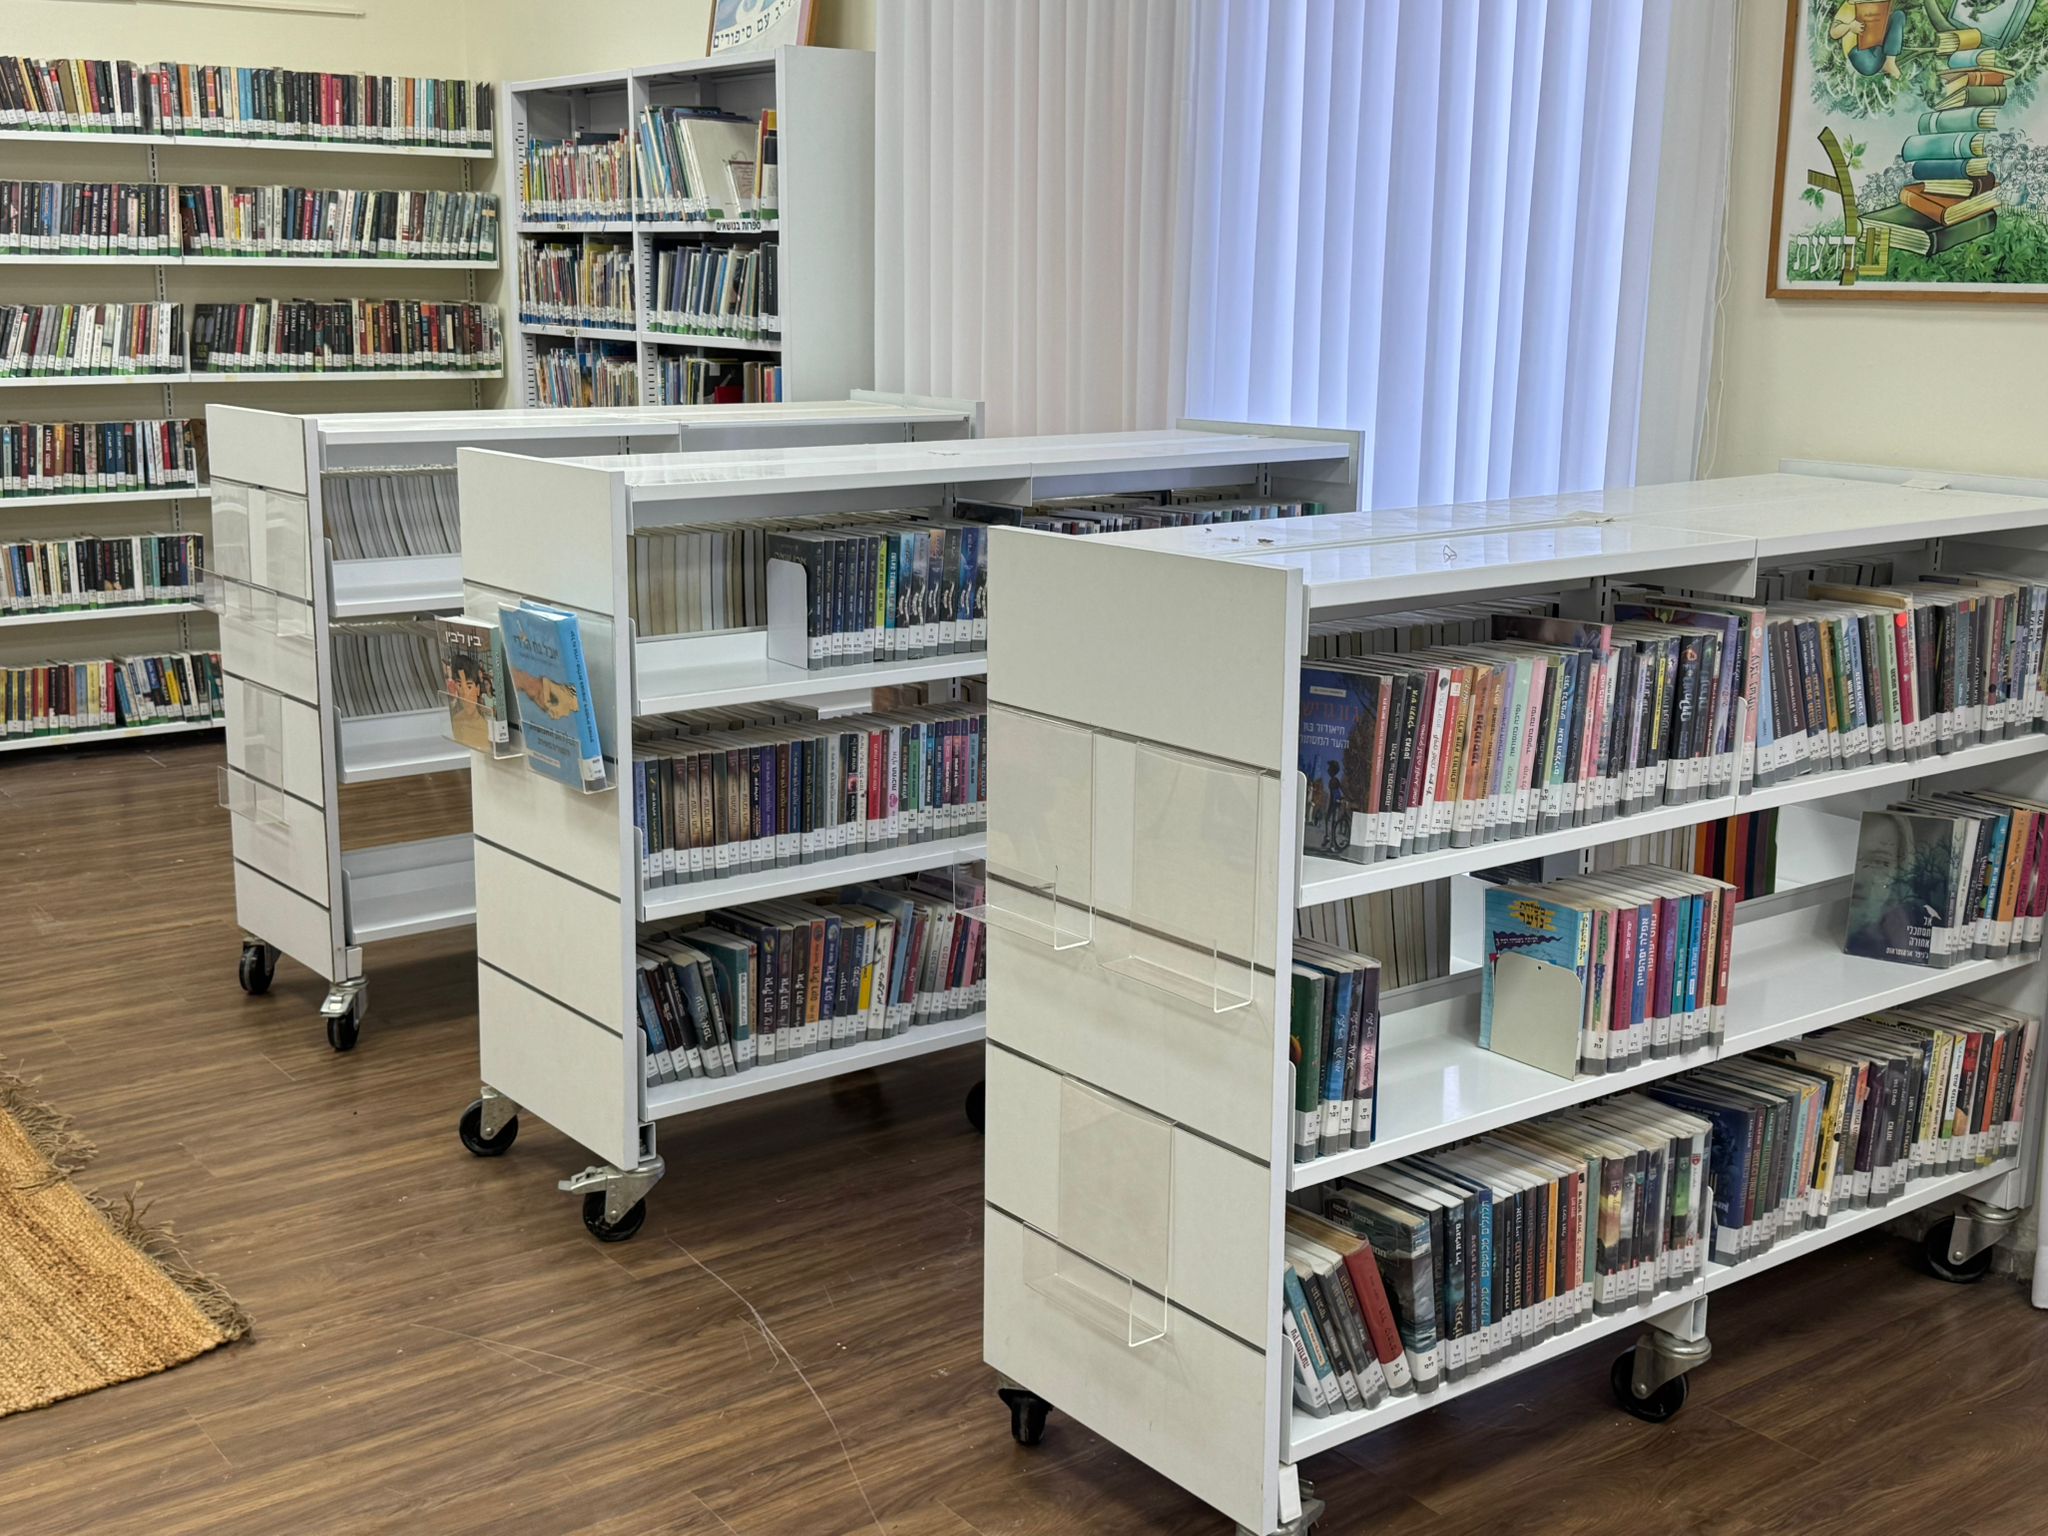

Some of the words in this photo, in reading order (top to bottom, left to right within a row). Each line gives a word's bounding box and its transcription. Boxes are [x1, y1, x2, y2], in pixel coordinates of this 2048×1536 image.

[713, 25, 752, 49] סיפורים
[1556, 727, 1564, 743] אגם
[1389, 742, 1397, 760] הילד
[1552, 745, 1562, 774] הצללים
[1638, 917, 1650, 944] אפלה
[1907, 926, 1931, 937] תסתכלי
[1923, 915, 1933, 926] אל
[1909, 937, 1929, 948] אחורה
[1633, 948, 1648, 985] יפהפייה
[1479, 1200, 1491, 1234] תלתלים
[1453, 1223, 1462, 1250] סיגלית
[1453, 1252, 1462, 1264] דיל
[1478, 1238, 1490, 1277] מכושפים
[1512, 1263, 1522, 1306] הפאנדום
